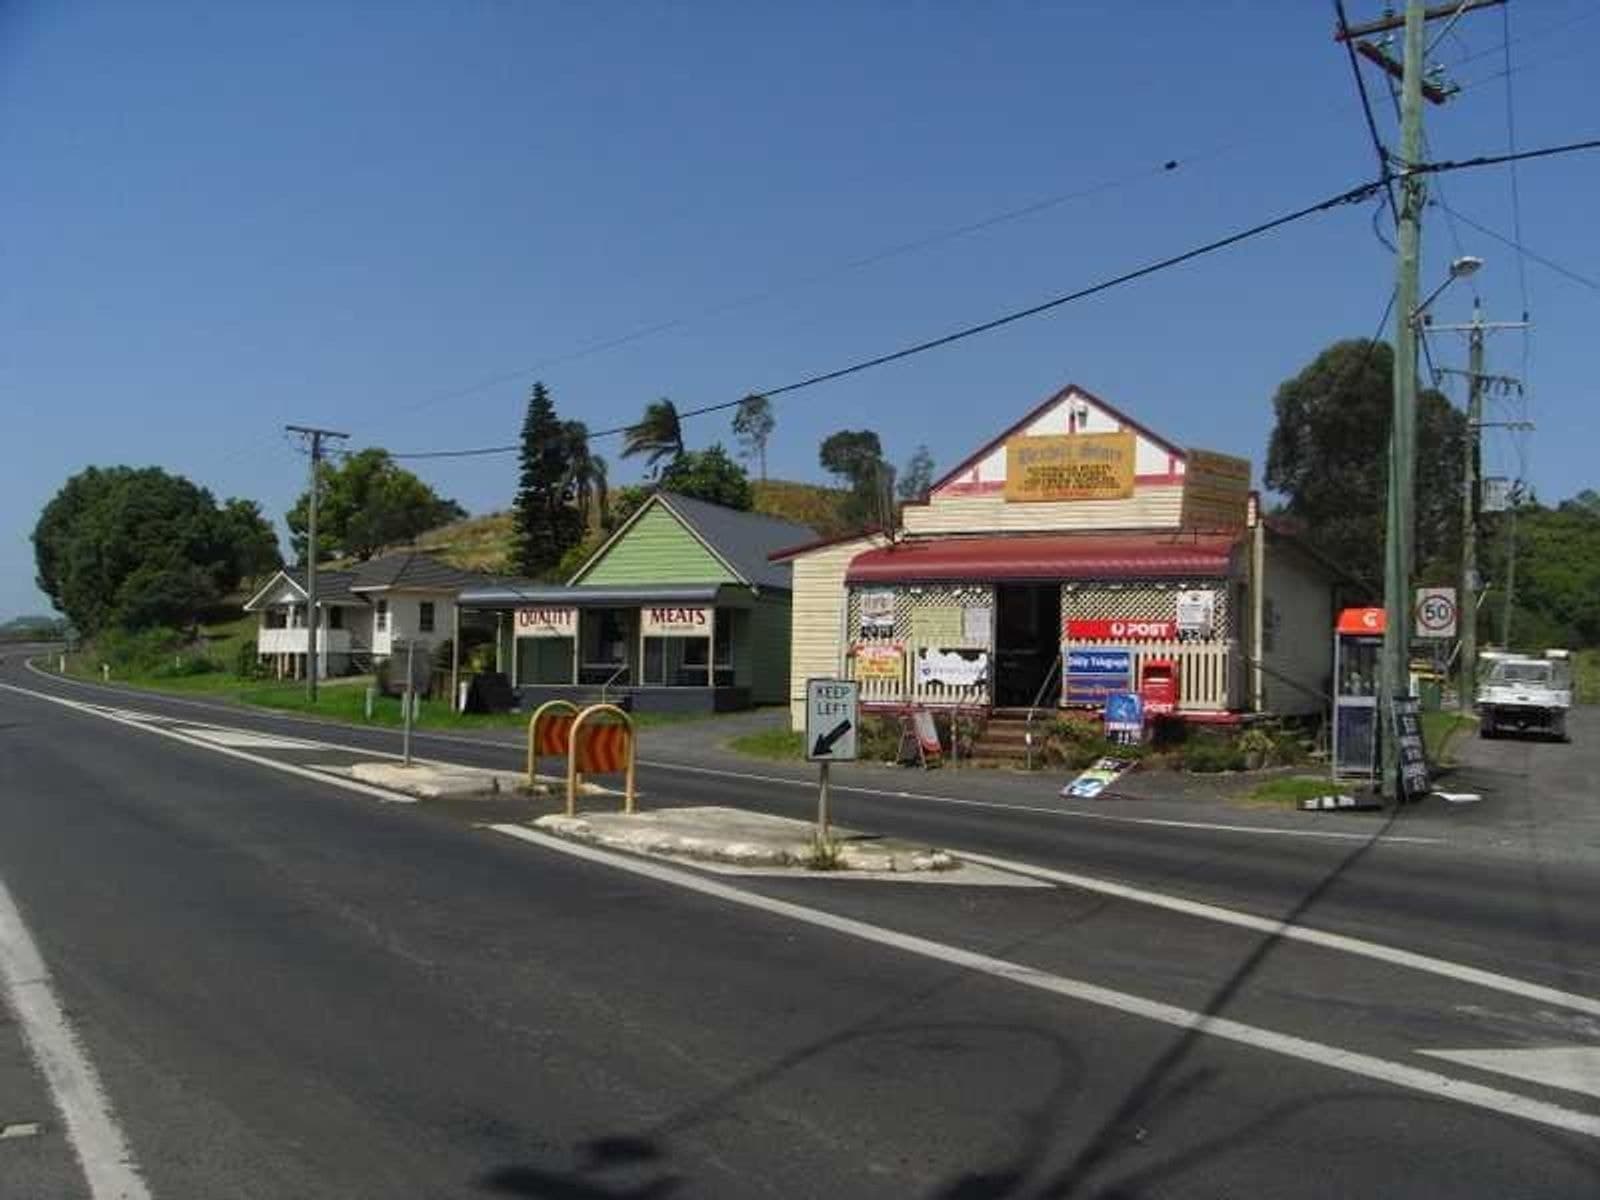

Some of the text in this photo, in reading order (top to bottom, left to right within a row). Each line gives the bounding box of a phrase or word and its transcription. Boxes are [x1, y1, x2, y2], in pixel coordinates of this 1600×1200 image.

[519, 607, 572, 627] QUALITY
[651, 607, 706, 625] MEATS
[1425, 603, 1448, 619] 50
[1127, 623, 1170, 637] POST
[815, 685, 852, 699] KEEP
[816, 702, 848, 715] LEFT
[1143, 703, 1173, 713] POST
